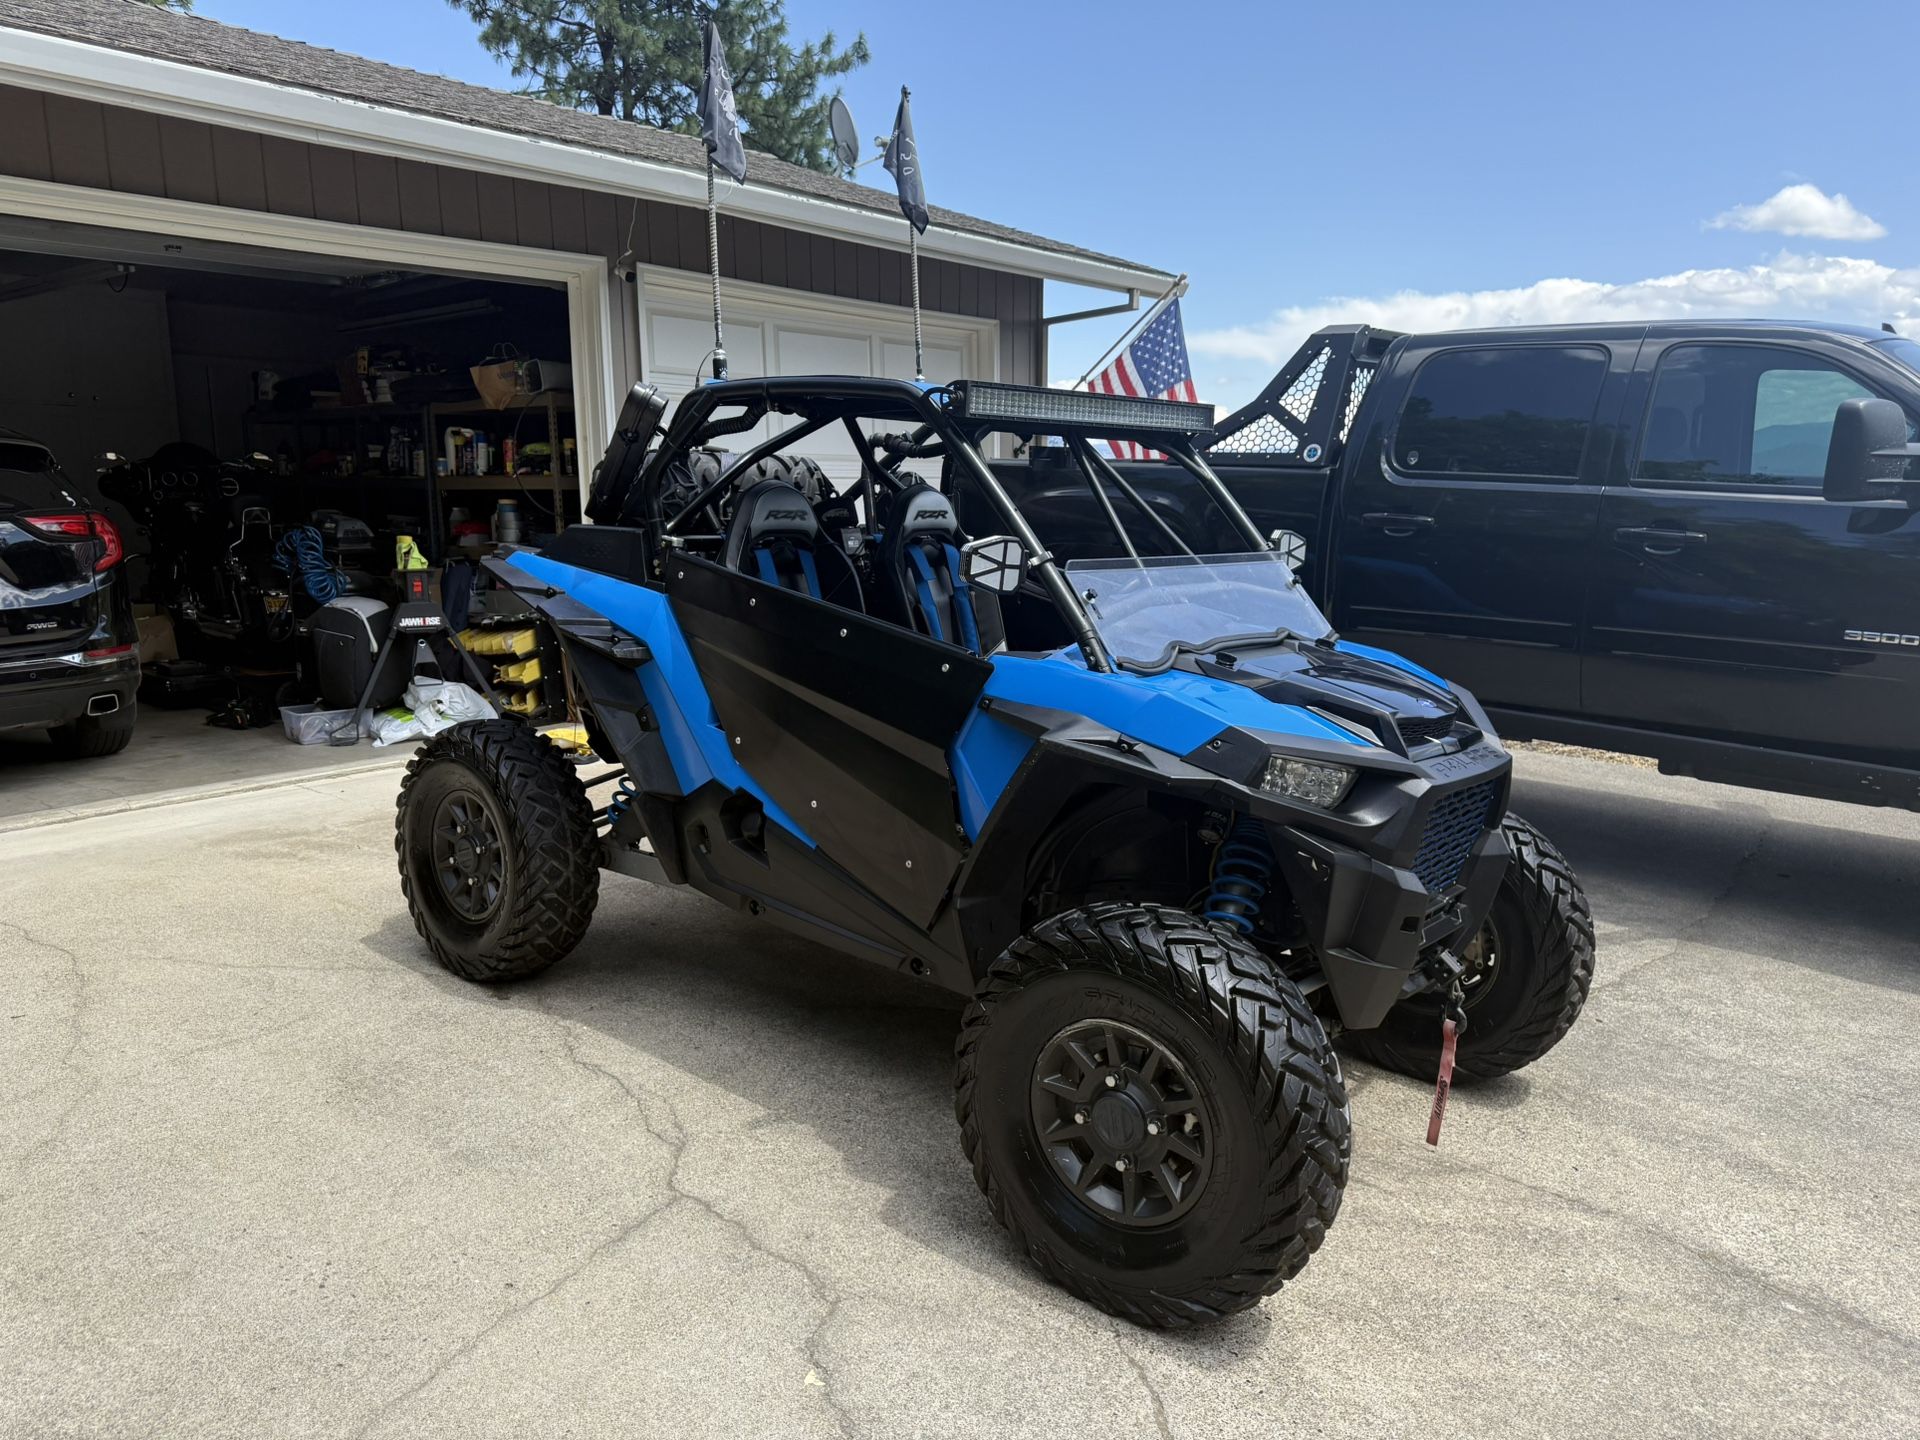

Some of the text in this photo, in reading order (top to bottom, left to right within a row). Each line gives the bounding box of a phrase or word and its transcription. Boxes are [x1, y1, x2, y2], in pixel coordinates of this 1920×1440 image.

[764, 509, 809, 521] RZR
[913, 510, 948, 521] RZR
[1843, 629, 1920, 646] 3500
